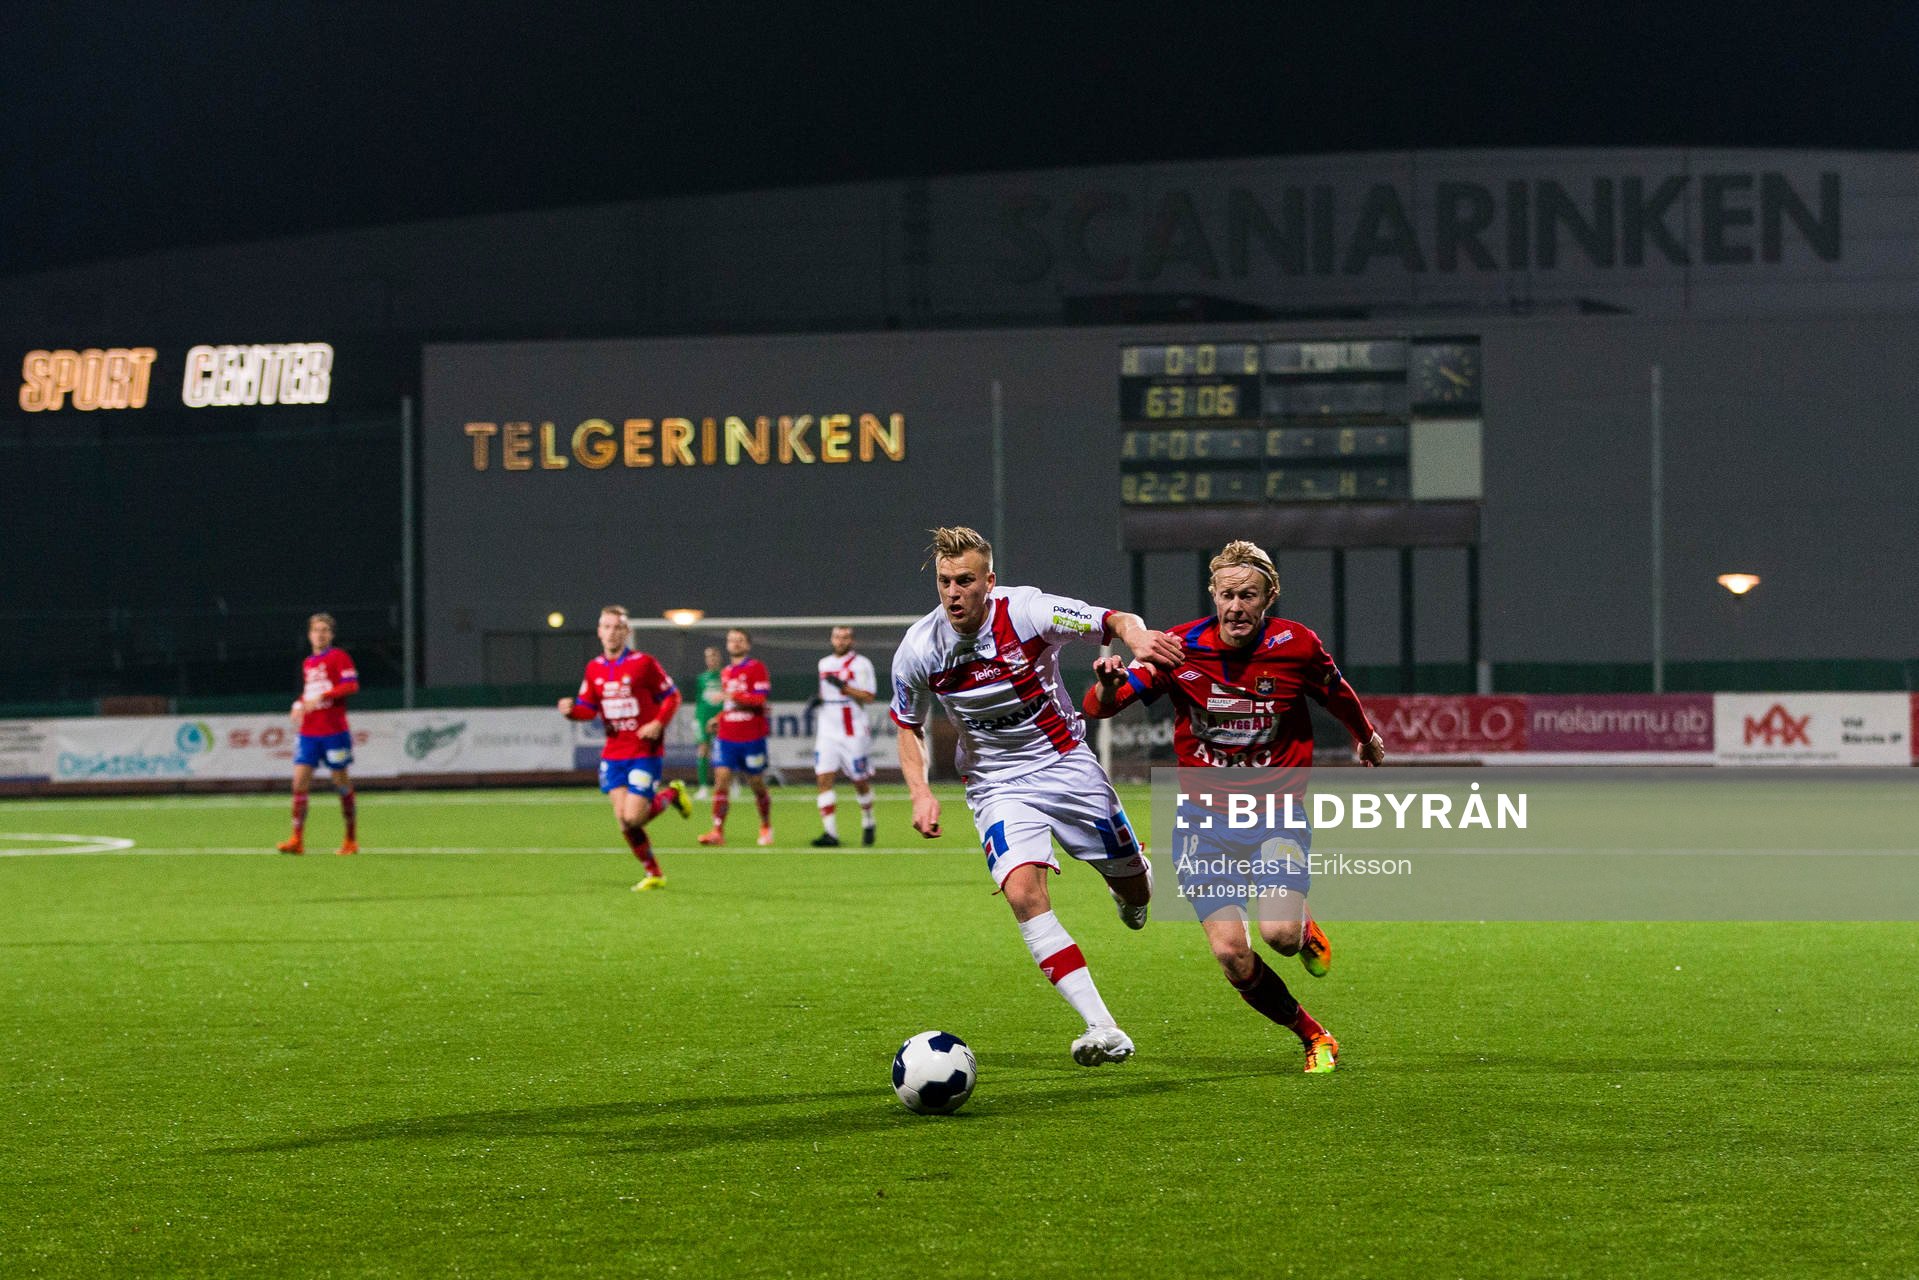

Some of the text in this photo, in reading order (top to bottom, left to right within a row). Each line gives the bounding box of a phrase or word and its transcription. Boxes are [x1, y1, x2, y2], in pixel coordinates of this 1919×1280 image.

[994, 172, 1841, 281] SCANIARINKEN
[19, 343, 334, 412] SPORT CENTER
[464, 413, 906, 472] TELGERINKEN
[971, 666, 1001, 681] Telge
[1533, 705, 1667, 733] melammu
[1744, 704, 1812, 747] MAX
